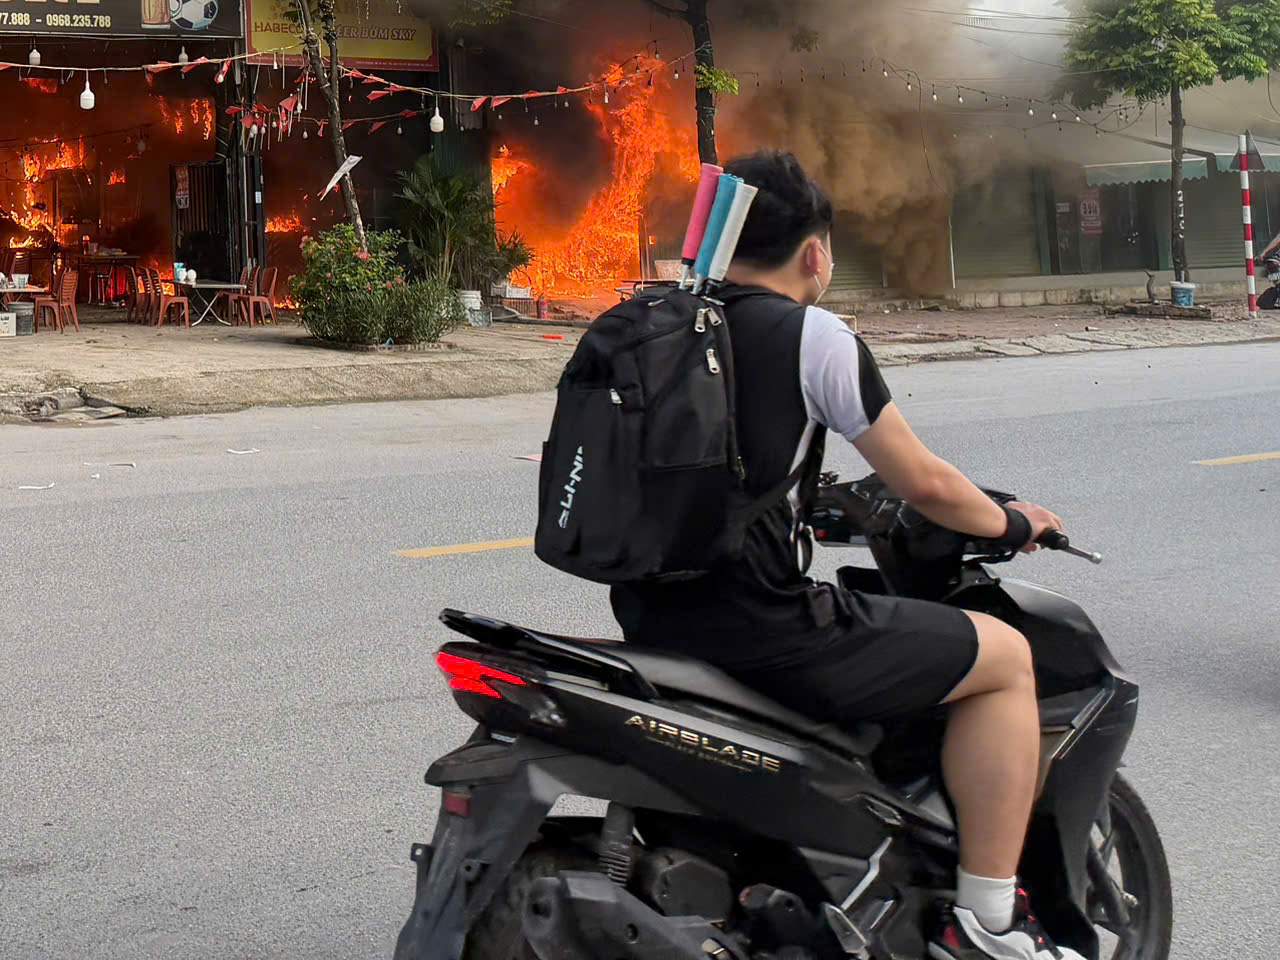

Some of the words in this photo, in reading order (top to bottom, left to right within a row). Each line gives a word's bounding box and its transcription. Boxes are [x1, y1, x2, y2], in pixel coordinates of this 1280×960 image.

[46, 14, 111, 28] 0968.235.788
[254, 22, 304, 34] HABECO
[391, 28, 417, 41] SKY
